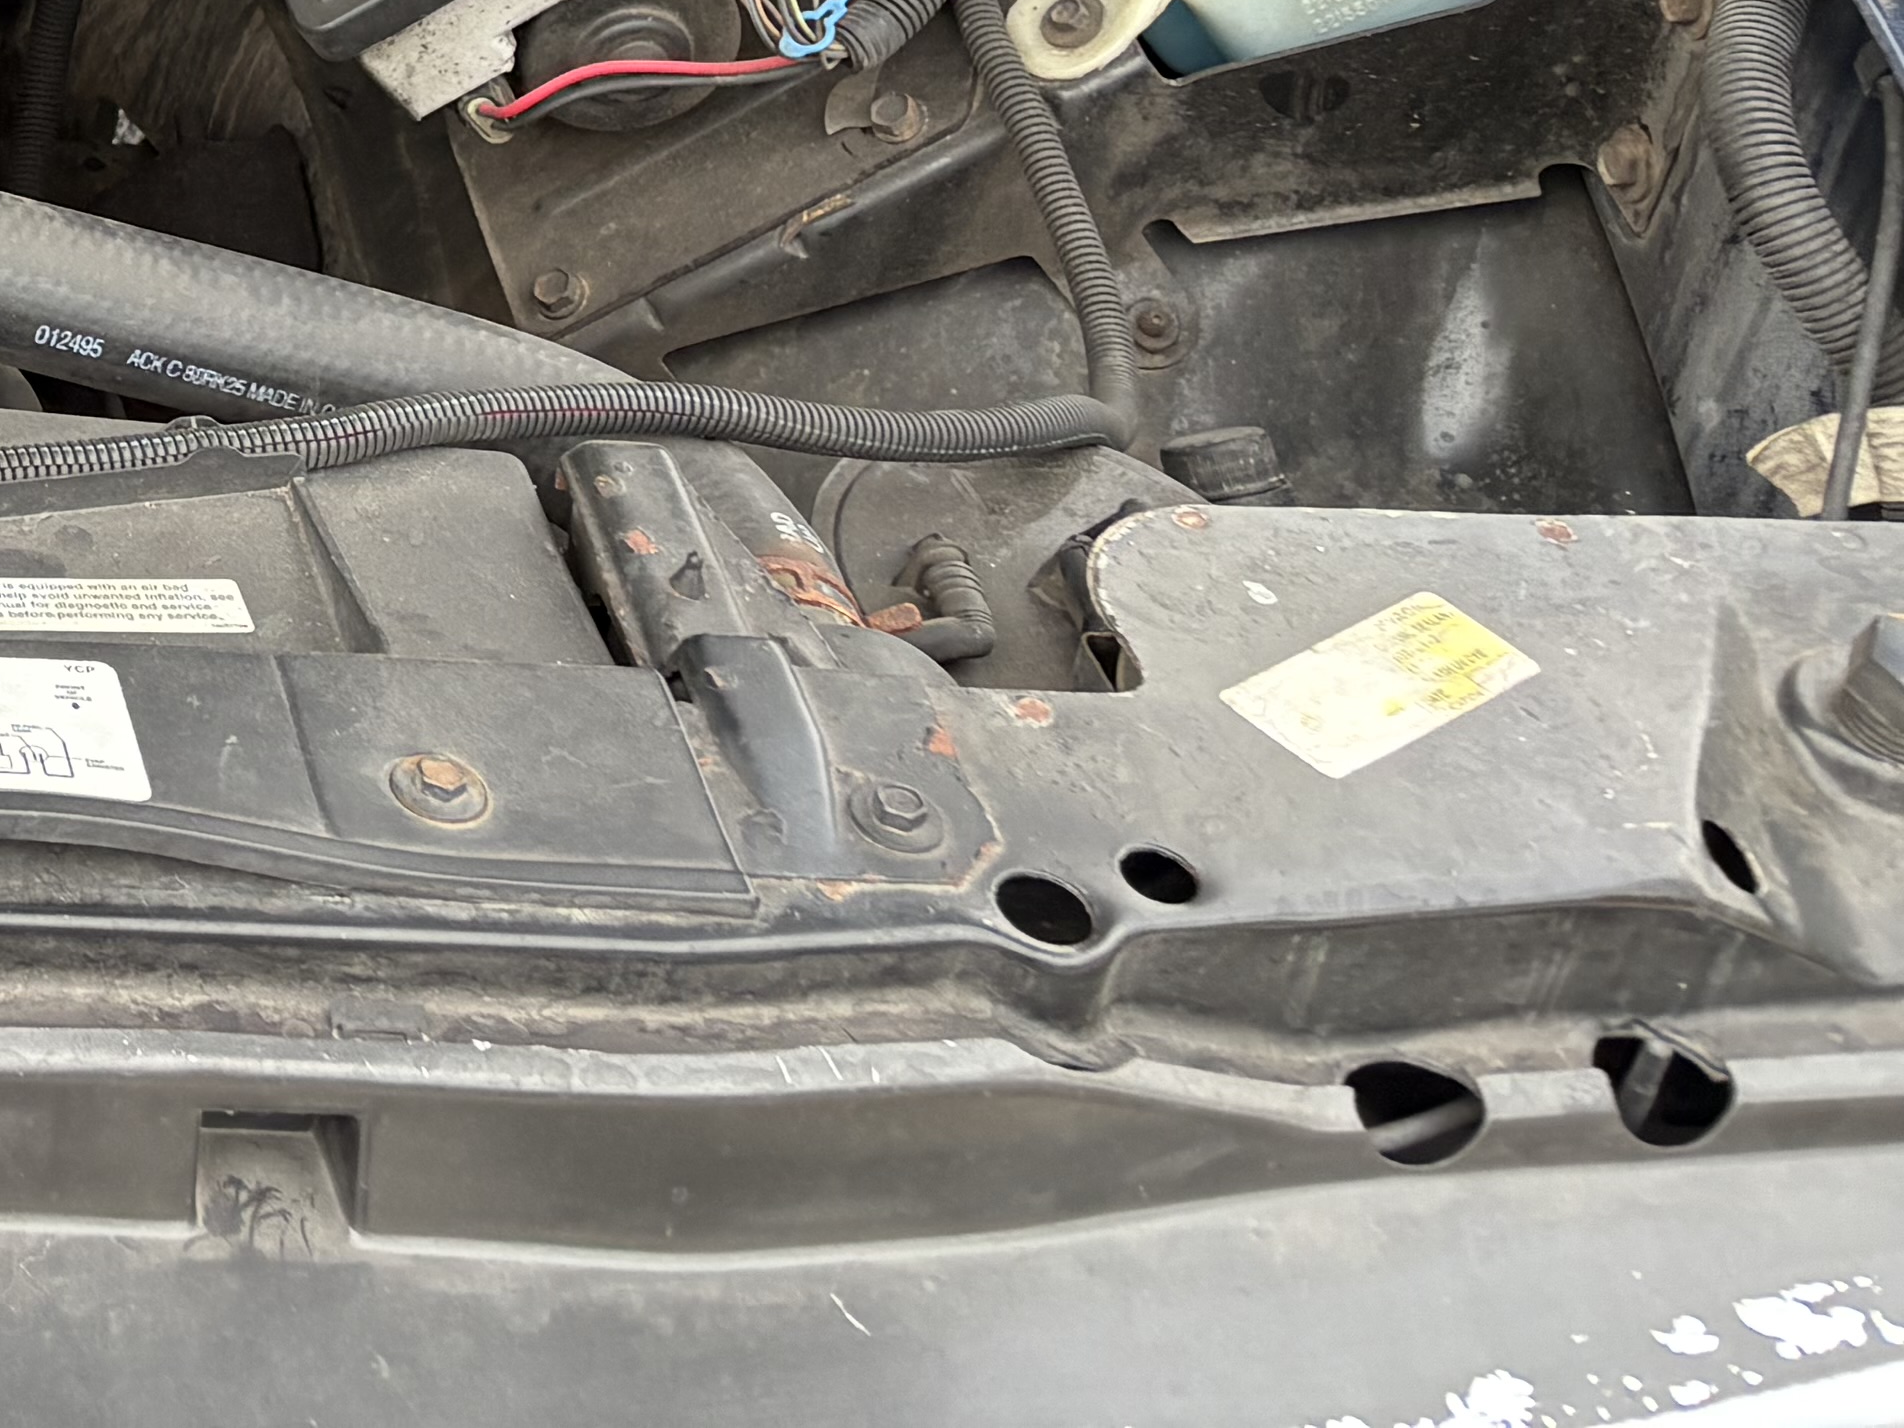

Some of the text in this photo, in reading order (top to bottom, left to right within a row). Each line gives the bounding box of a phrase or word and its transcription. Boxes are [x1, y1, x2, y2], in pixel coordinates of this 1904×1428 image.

[35, 325, 105, 358] 012495
[127, 349, 166, 374] ACK
[166, 360, 182, 377] C
[247, 383, 298, 412] MADE
[298, 396, 320, 415] IN
[18, 582, 84, 592] equipped
[87, 583, 117, 591] with
[74, 593, 142, 601] unwanted
[64, 664, 95, 673] YCP
